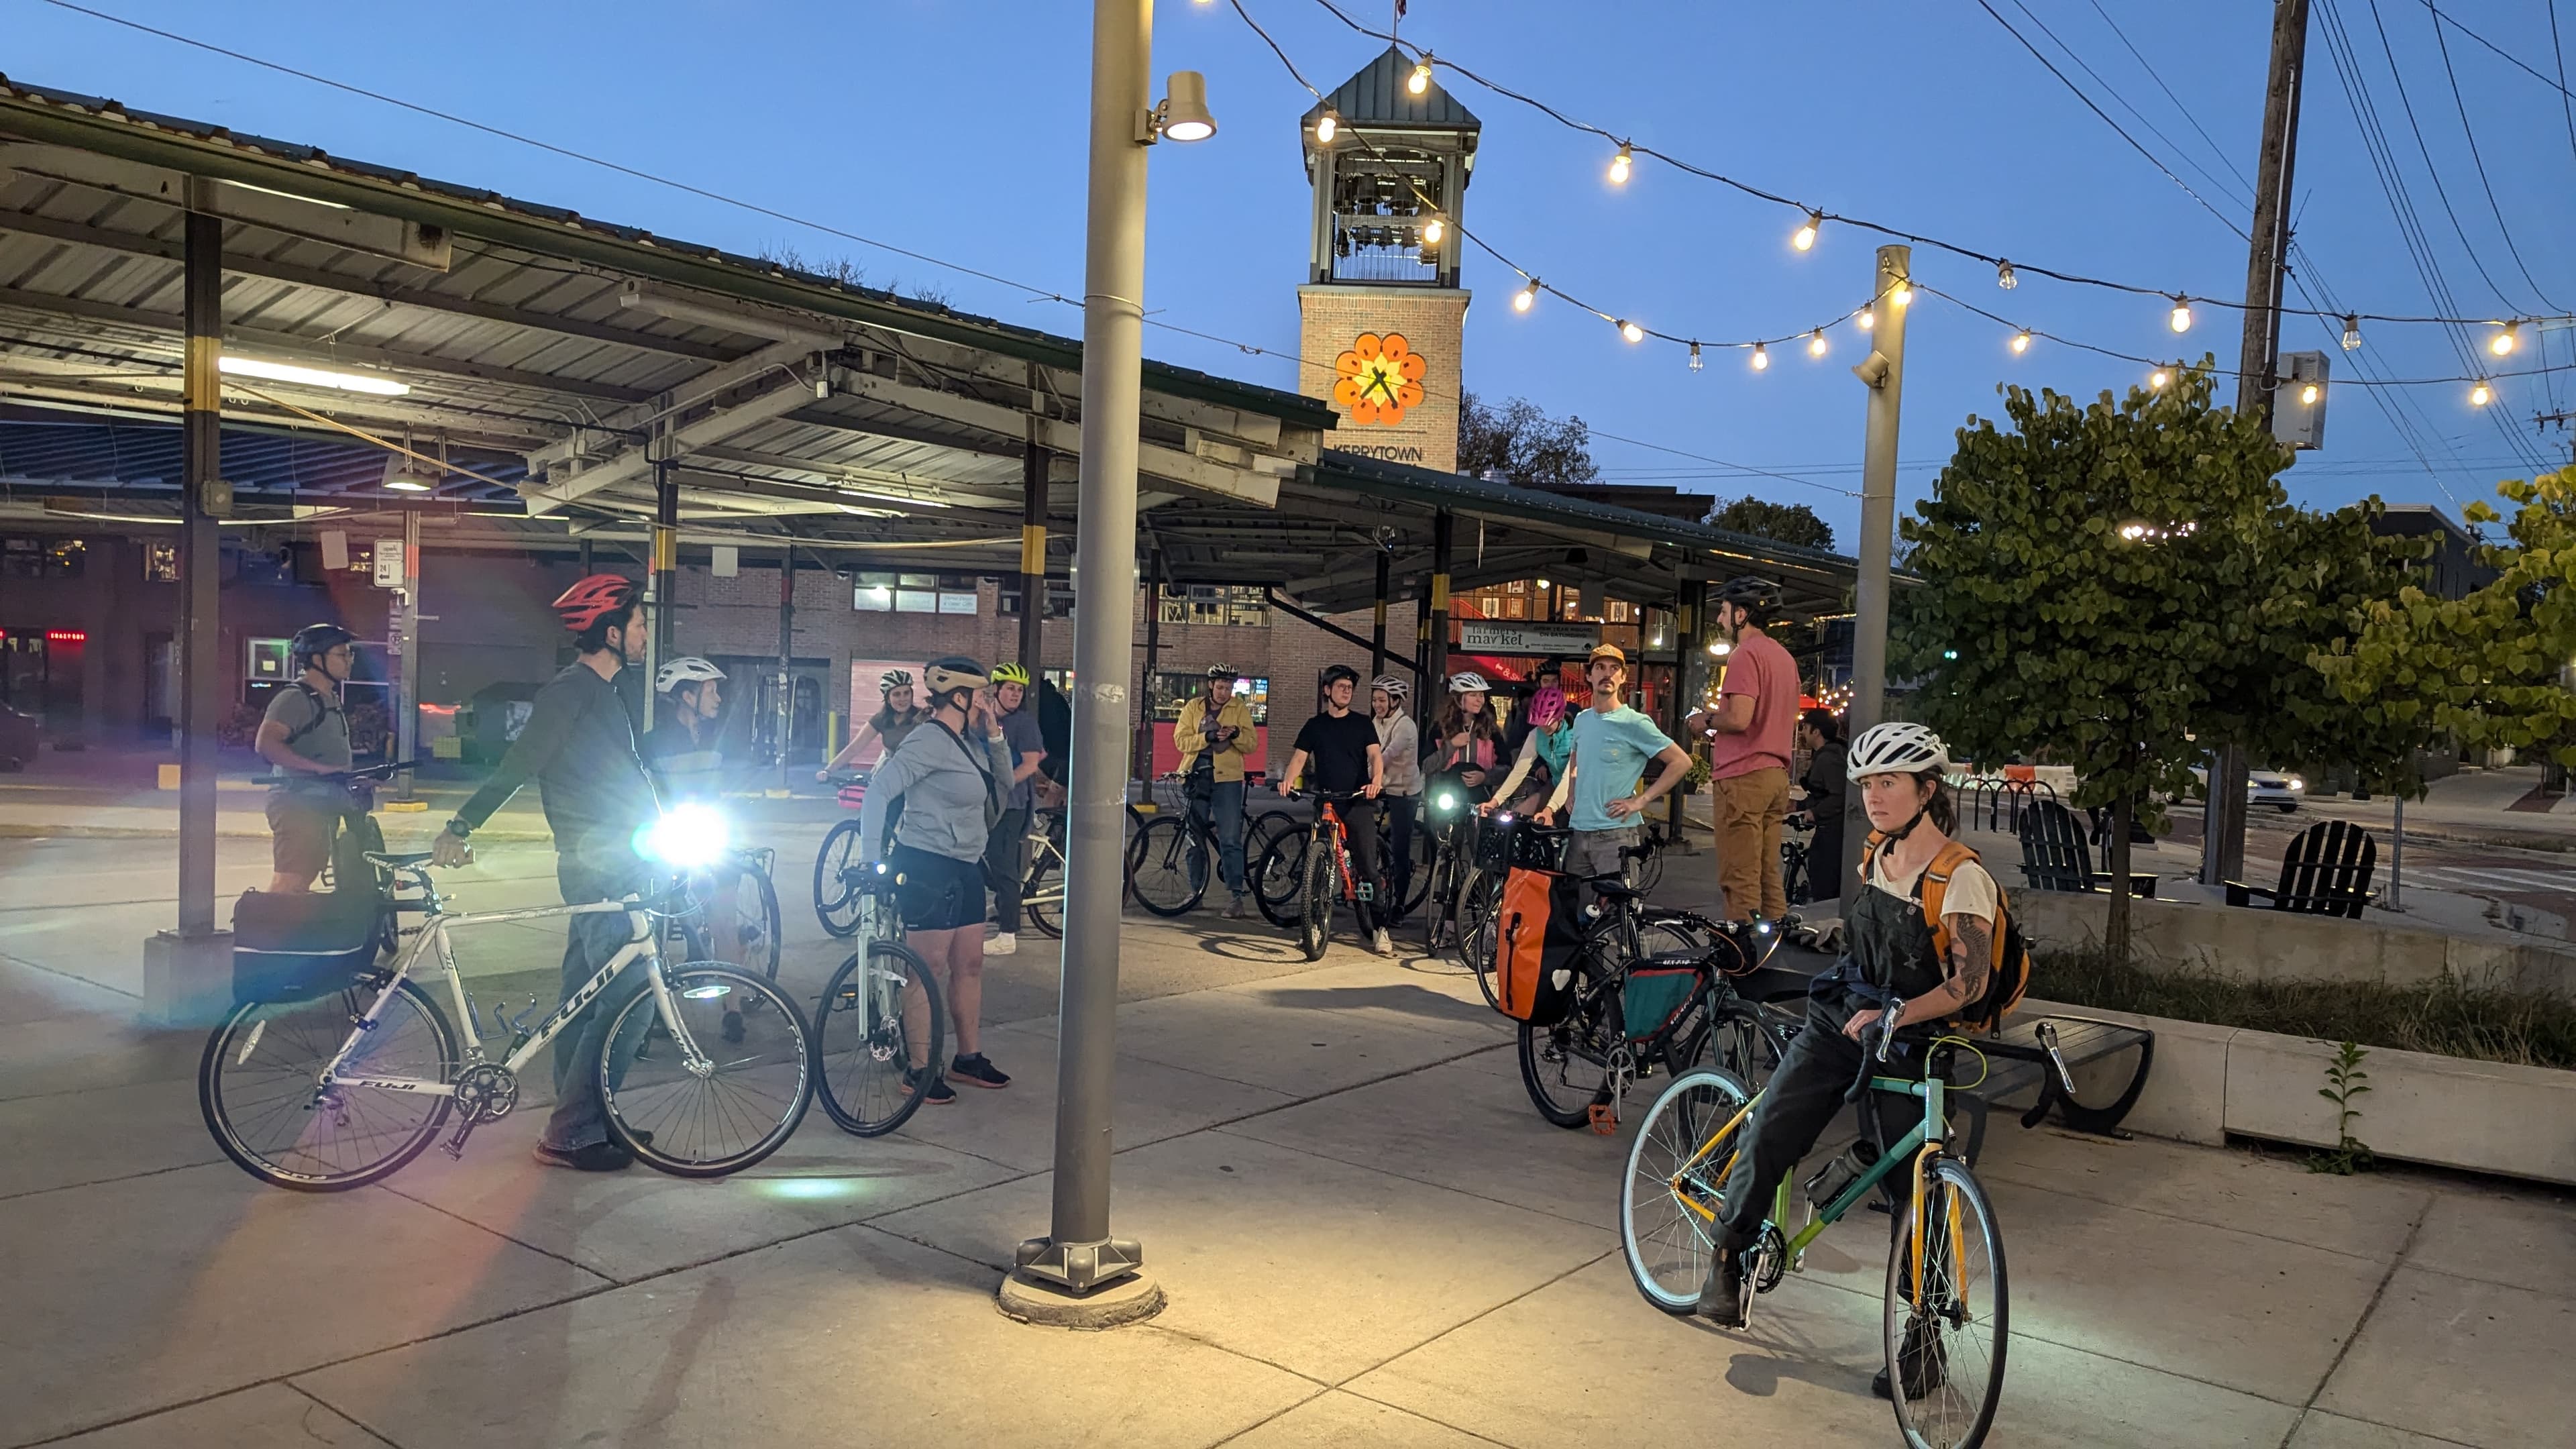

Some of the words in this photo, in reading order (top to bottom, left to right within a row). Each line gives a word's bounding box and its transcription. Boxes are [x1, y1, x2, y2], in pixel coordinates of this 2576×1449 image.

[1472, 627, 1517, 635] farmers
[541, 965, 614, 1040] FUJI
[671, 1028, 692, 1059] FUJI
[360, 1080, 417, 1090] FUJI
